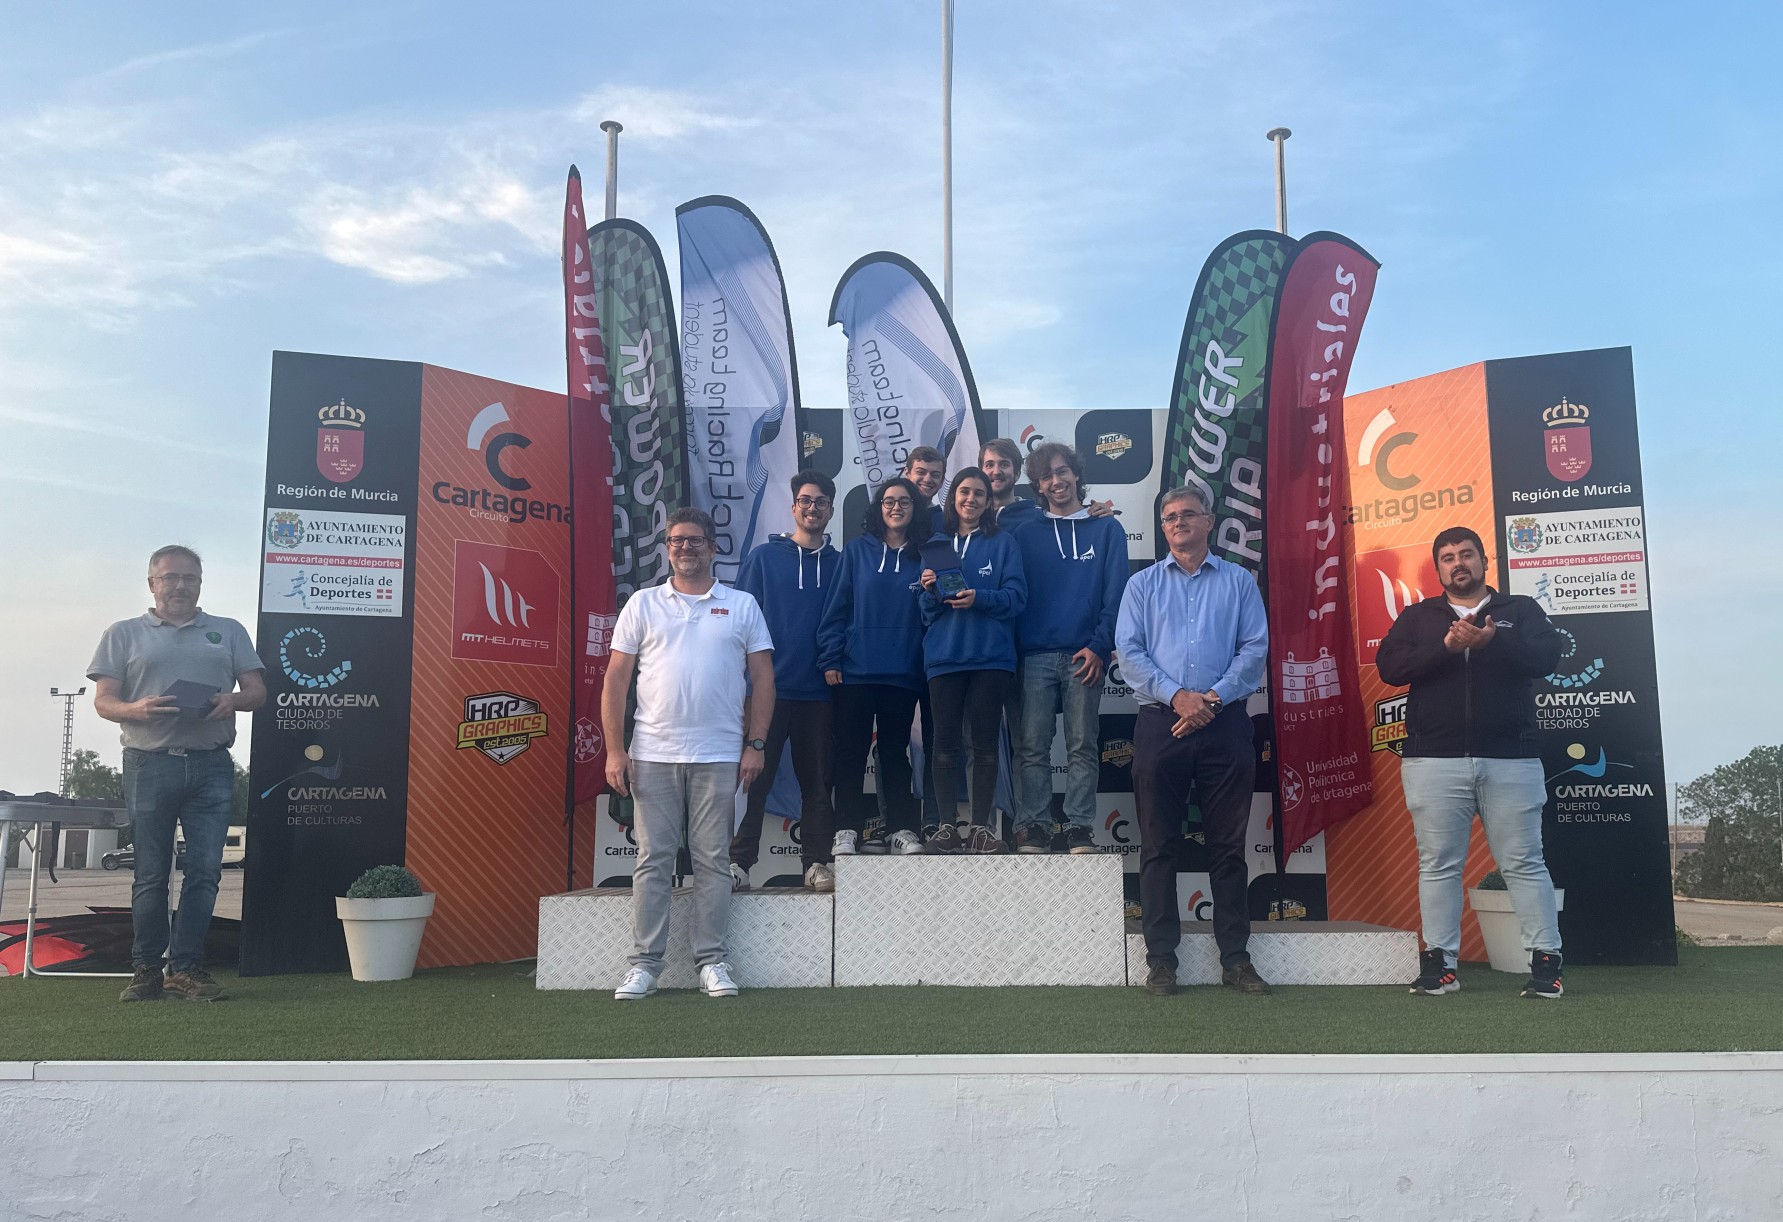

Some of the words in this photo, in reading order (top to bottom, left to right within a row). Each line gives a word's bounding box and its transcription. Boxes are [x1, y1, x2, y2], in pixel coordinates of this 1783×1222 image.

[277, 483, 326, 499] Región
[329, 486, 347, 499] de
[351, 488, 399, 502] Murcia
[1512, 488, 1560, 504] Región
[1563, 485, 1580, 498] de
[1584, 482, 1632, 497] Murcia
[1342, 484, 1474, 525] artagena
[469, 508, 509, 523] Circuito
[306, 521, 404, 535] AYUNTAMIENTO
[1364, 517, 1402, 531] Circuito
[1544, 517, 1641, 533] AYUNTAMIENTO
[306, 534, 323, 544] DE
[326, 535, 403, 548] CARTAGENA
[1545, 535, 1562, 545] DE
[1564, 530, 1642, 545] CARTAGENA
[275, 554, 400, 568] www.cartagena.es/deportes
[1518, 552, 1641, 567] www.cartagena.es/deportes
[311, 573, 375, 587] Concejalía
[378, 576, 393, 587] de
[1554, 571, 1617, 584] Concejalía
[1620, 570, 1636, 581] de
[310, 586, 372, 600] Deportes
[1555, 586, 1616, 600] Deportes
[315, 604, 355, 612] Ayuntamiento
[363, 606, 392, 614] Cartagena
[1561, 604, 1601, 612] Ayuntamiento
[484, 635, 550, 649] HELMETS
[276, 692, 380, 707] CARTAGENA
[1535, 691, 1636, 707] CARTAGENA
[276, 709, 325, 719] CIUDAD
[328, 709, 343, 719] DE
[471, 700, 519, 721] HRP
[1536, 708, 1582, 719] CIUDAD
[1585, 707, 1601, 717] DE
[275, 719, 331, 730] TESOROS
[463, 716, 542, 739] GRAPHICS
[1535, 718, 1590, 730] TESOROS
[287, 786, 387, 800] CARTAGENA
[1555, 783, 1654, 798] CARTAGENA
[287, 804, 333, 814] PUERTO
[1557, 801, 1601, 811] PUERTO
[287, 817, 302, 825] DE
[305, 816, 362, 825] CULTURAS
[1557, 814, 1572, 823] DE
[1575, 813, 1632, 823] CULTURAS
